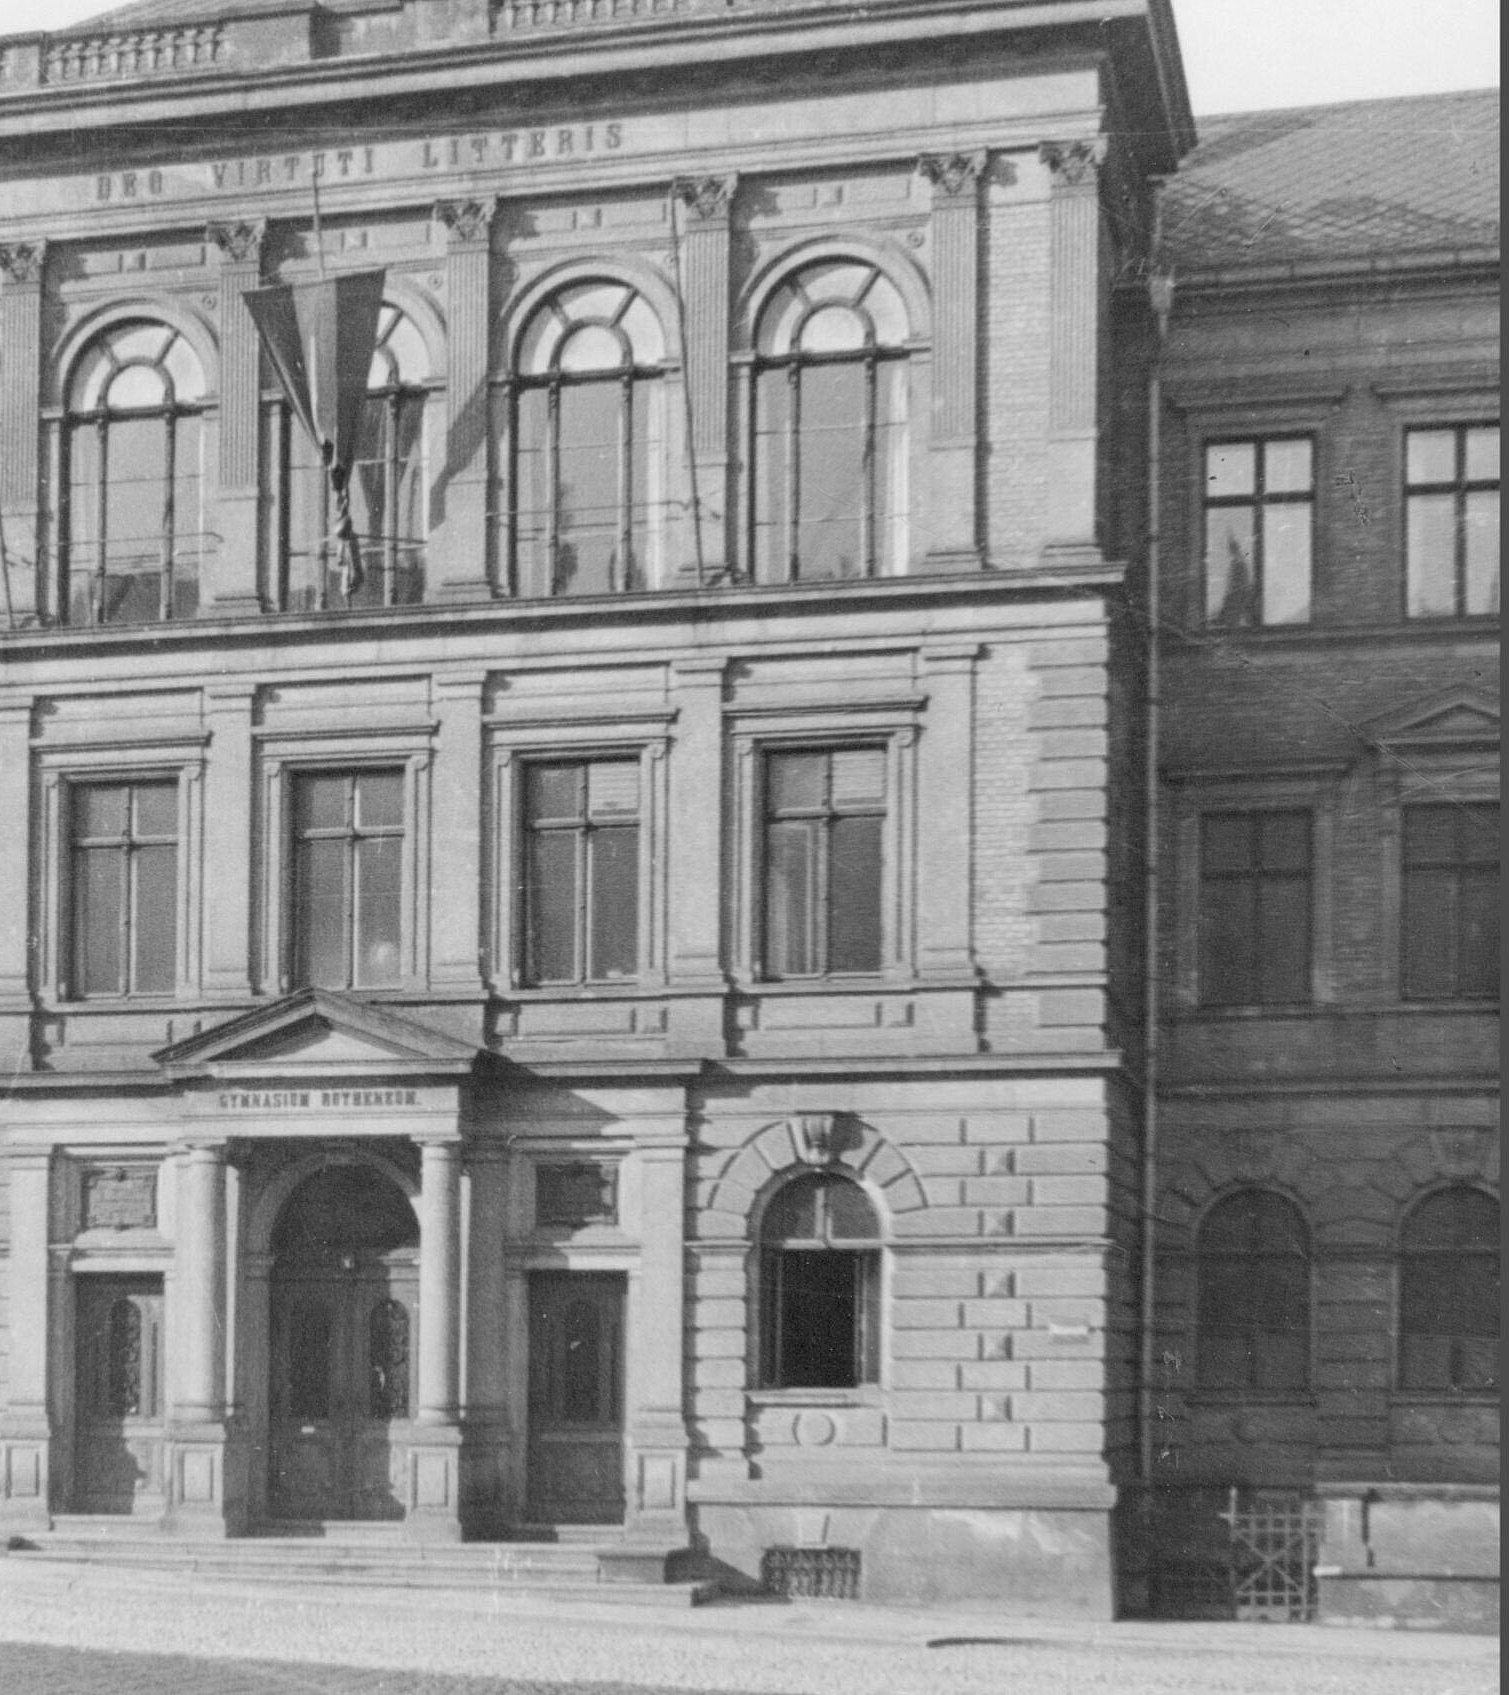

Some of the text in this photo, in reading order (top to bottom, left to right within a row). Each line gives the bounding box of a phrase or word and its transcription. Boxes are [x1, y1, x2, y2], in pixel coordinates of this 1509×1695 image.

[97, 122, 623, 200] DEO VIRTUTI LITTERIS
[219, 1091, 310, 1109] GYMNASIUM
